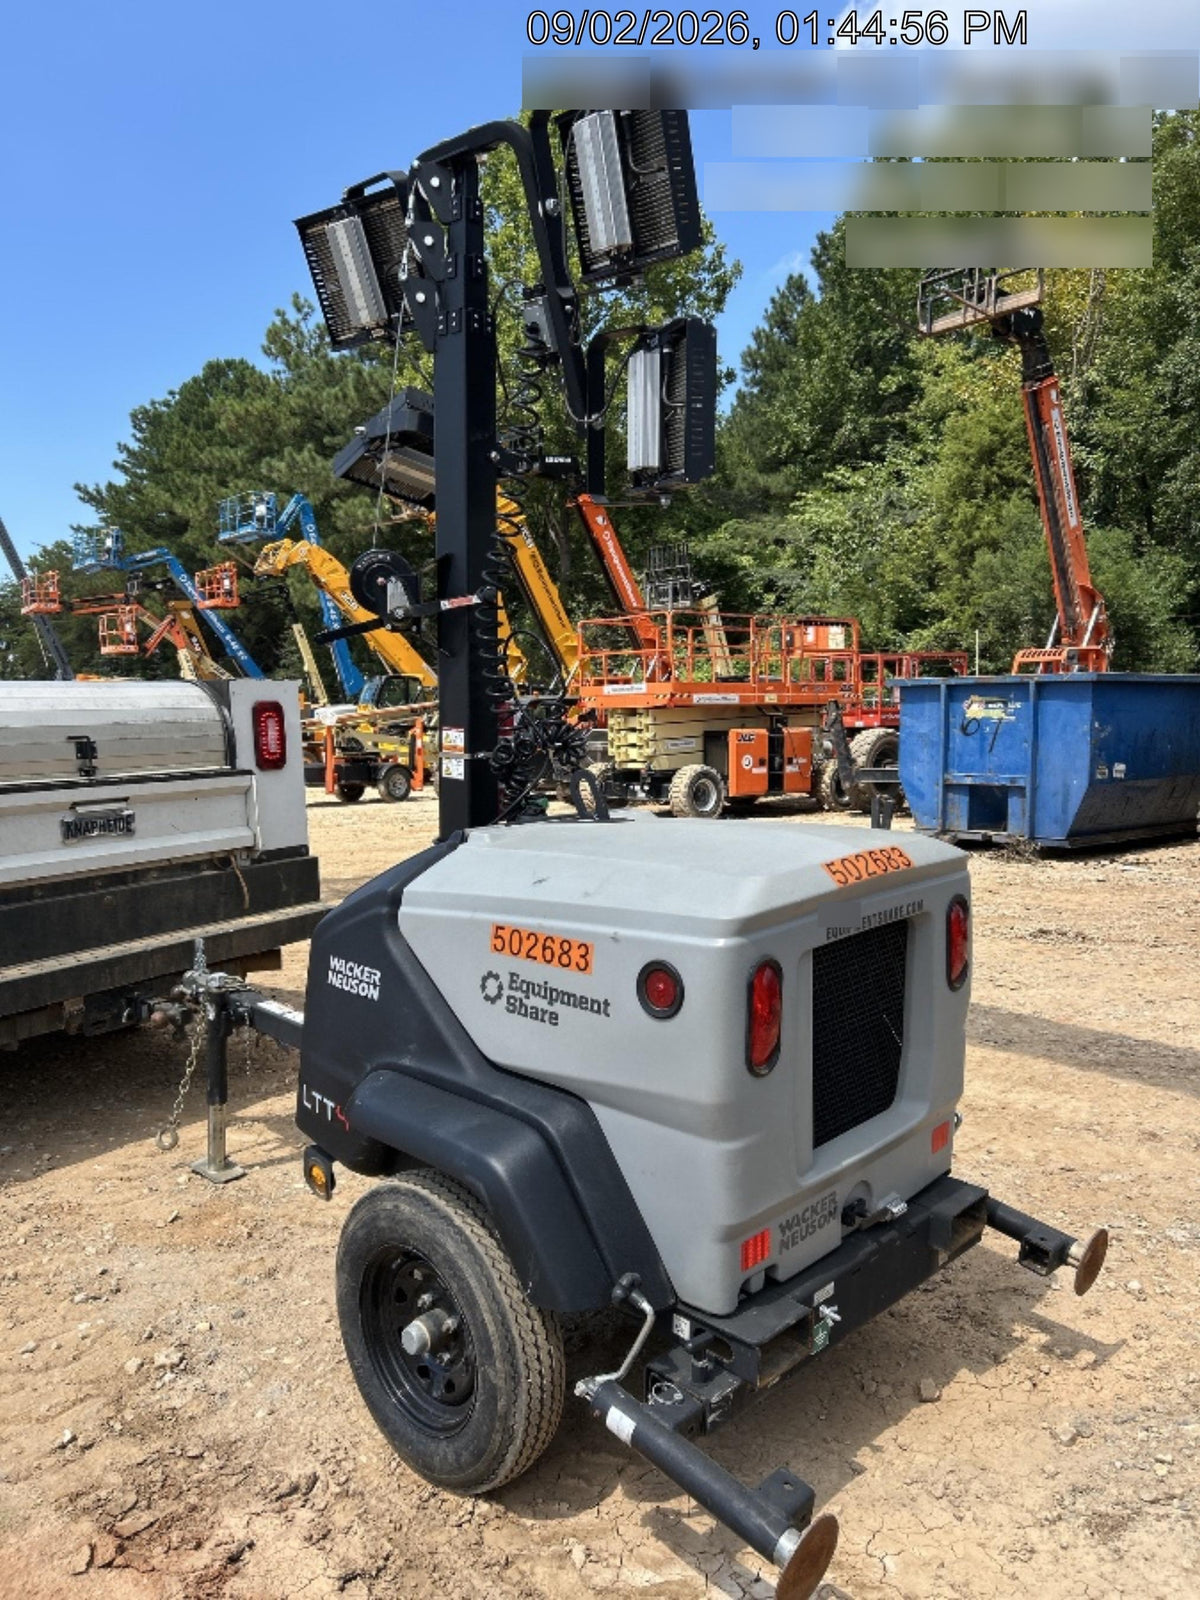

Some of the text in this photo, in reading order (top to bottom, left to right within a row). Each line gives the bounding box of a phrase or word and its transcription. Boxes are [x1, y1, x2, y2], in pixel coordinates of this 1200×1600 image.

[825, 847, 912, 885] 502683
[330, 955, 382, 986] WACKER
[493, 925, 589, 972] 502683
[328, 970, 380, 1001] NEUSON
[508, 971, 611, 1018] Equipment
[505, 994, 559, 1026] Share
[303, 1083, 349, 1132] LTT4
[779, 1190, 838, 1237] WACKER
[779, 1205, 838, 1256] NEUSON
